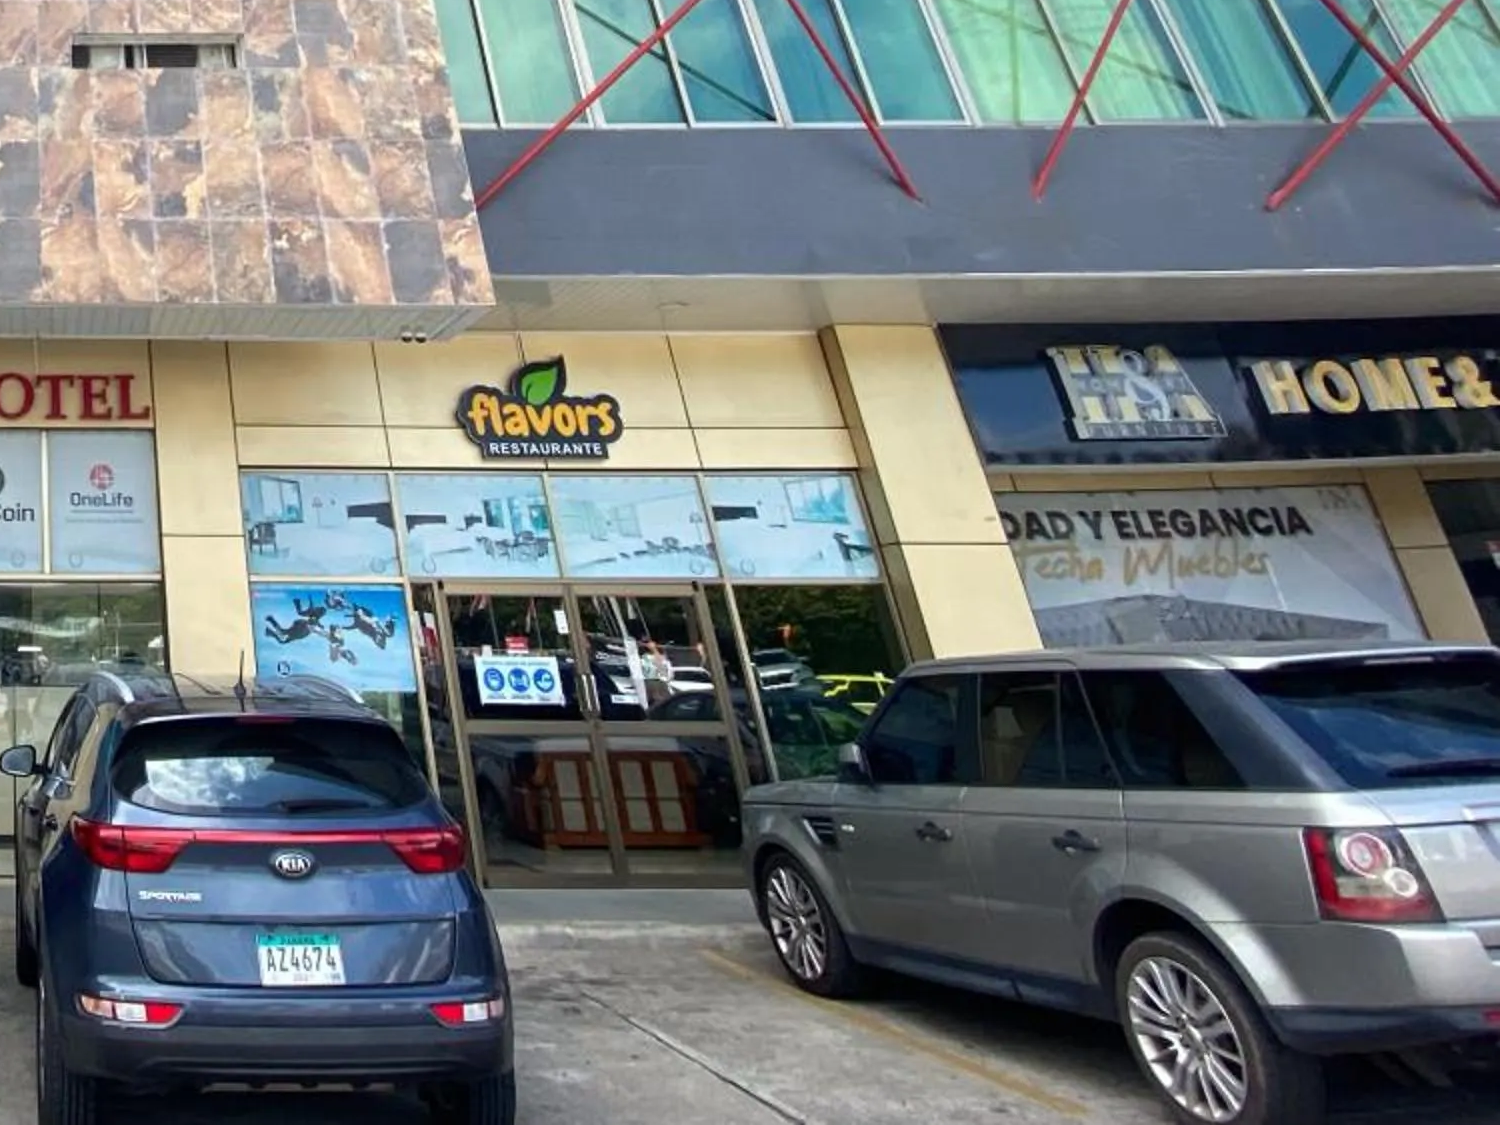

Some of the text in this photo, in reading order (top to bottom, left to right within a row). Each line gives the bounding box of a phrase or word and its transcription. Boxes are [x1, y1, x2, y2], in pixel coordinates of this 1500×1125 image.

[467, 392, 616, 438] flavors
[489, 442, 603, 455] RESTAURANTE
[69, 491, 134, 508] OneLife
[1077, 512, 1103, 540] Y
[1110, 505, 1315, 541] ELEGANCIA
[282, 855, 306, 870] KIA
[266, 946, 338, 972] AZ4674
